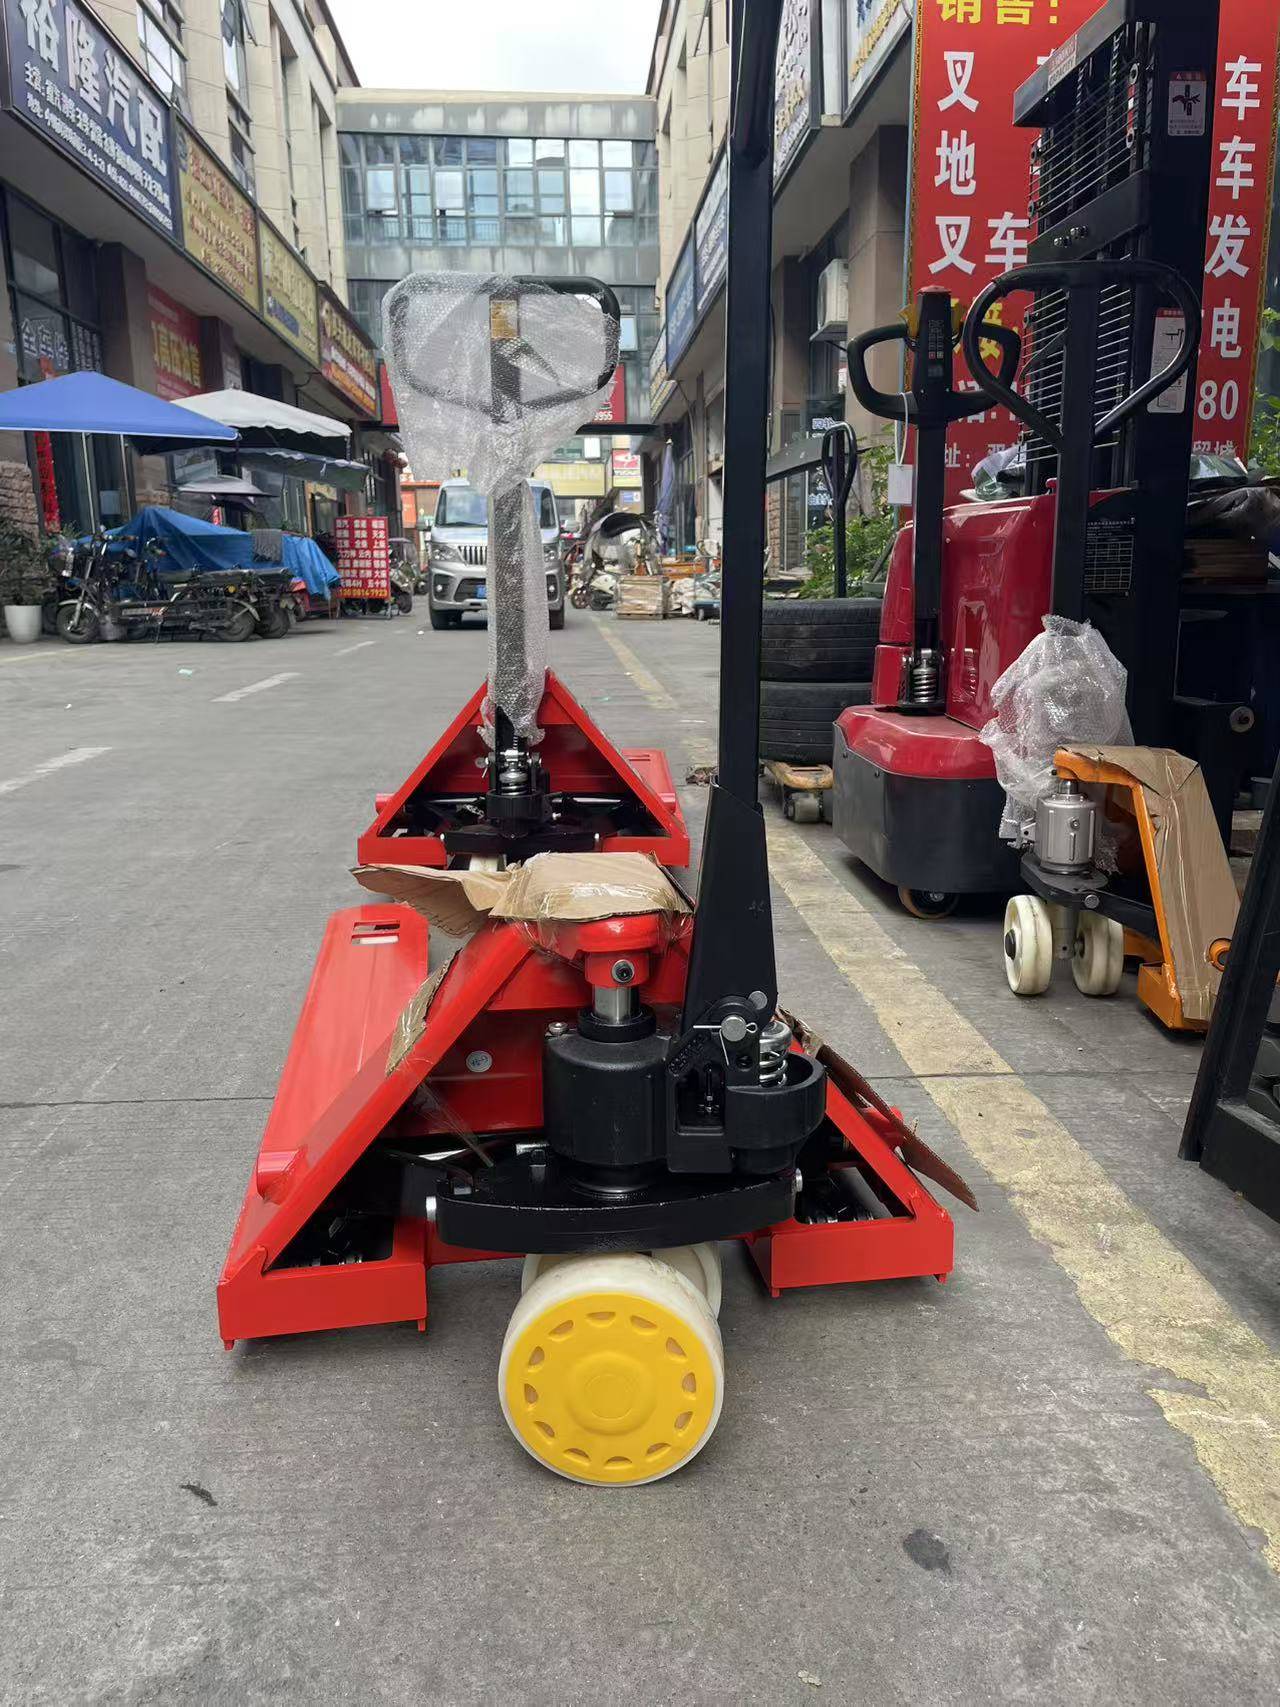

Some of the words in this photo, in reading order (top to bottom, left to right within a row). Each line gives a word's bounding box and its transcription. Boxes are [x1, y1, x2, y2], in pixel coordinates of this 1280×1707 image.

[936, 50, 980, 113] 叉
[1221, 55, 1262, 121] 车
[934, 129, 977, 196] 地
[1215, 135, 1256, 200] 车
[927, 211, 1029, 276] 叉车
[1204, 213, 1251, 279] 发
[1210, 297, 1242, 359] 电
